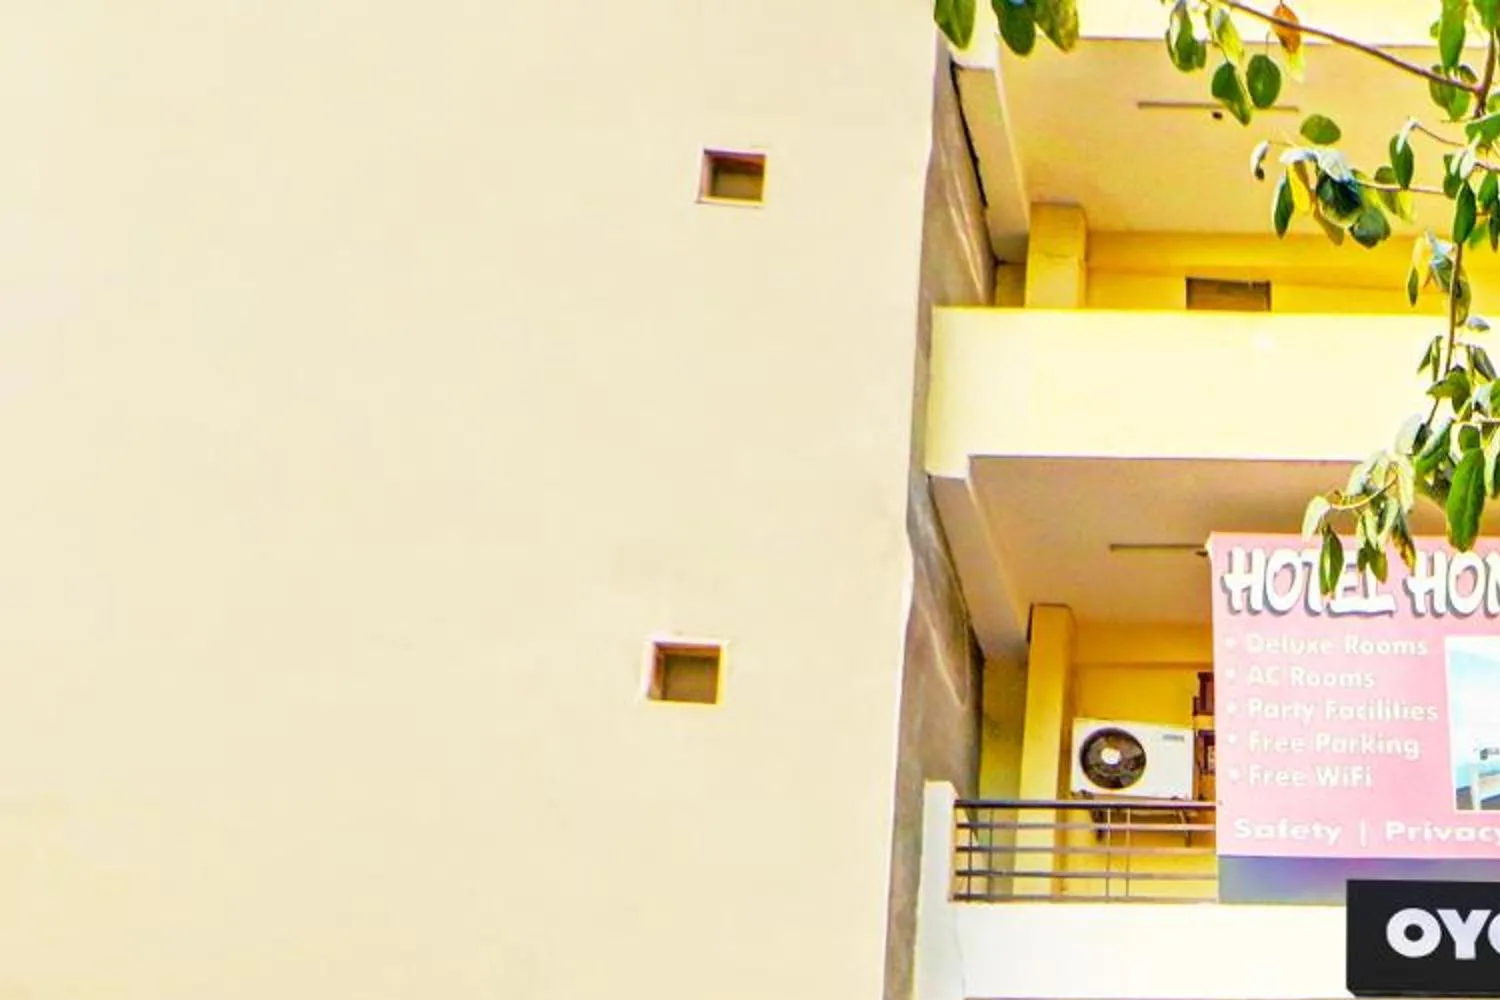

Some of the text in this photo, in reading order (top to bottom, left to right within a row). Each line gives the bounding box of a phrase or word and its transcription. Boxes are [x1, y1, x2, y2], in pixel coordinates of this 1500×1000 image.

[1222, 546, 1397, 617] HOTEL
[1247, 634, 1429, 656] Deluxe Rooms
[1248, 666, 1375, 688] AC Rooms
[1248, 698, 1314, 725] Party
[1249, 732, 1421, 760] Free Parking
[1249, 765, 1373, 788] Free WiFi
[1234, 818, 1343, 845] Safety
